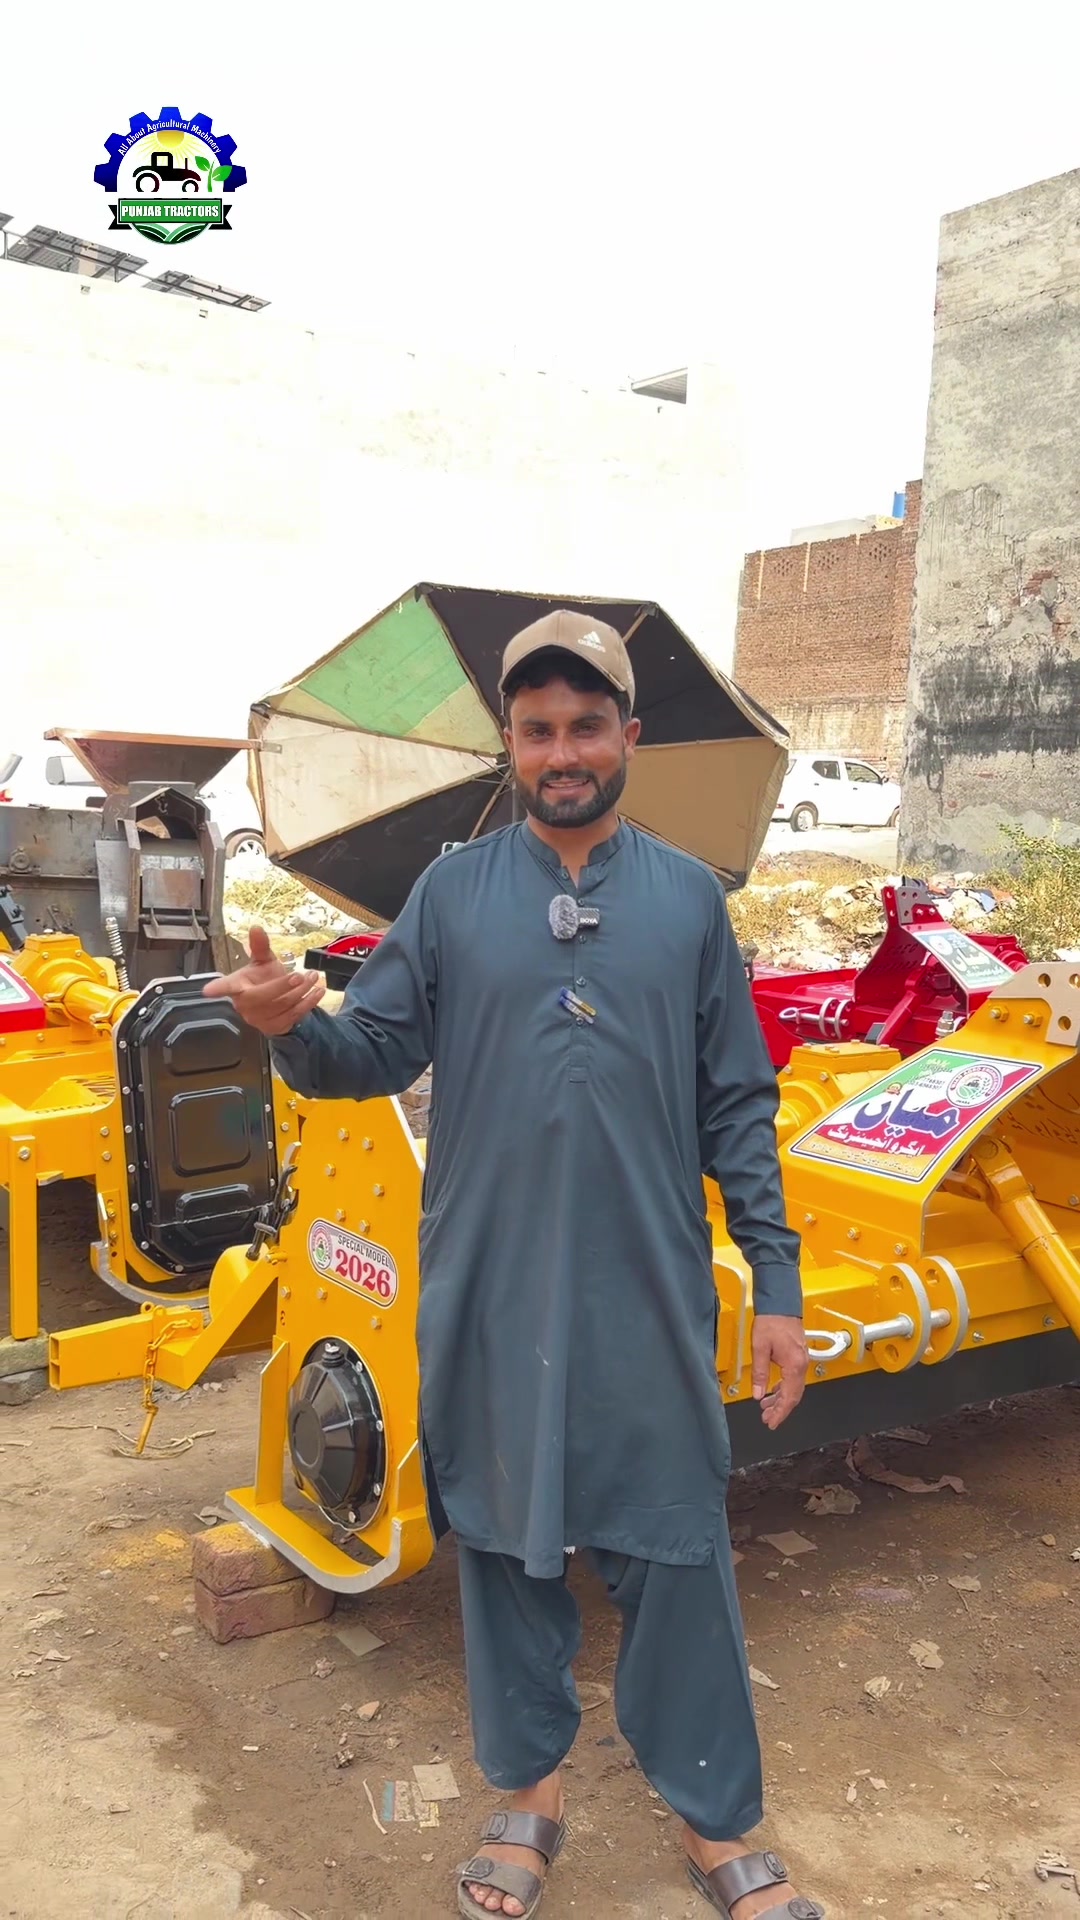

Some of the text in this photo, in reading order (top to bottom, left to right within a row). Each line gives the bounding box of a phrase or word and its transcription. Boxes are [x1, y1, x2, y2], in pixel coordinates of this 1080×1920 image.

[854, 1089, 959, 1137] میاں
[335, 1248, 391, 1298] 2026
[337, 1234, 364, 1256] SPECIAL
[365, 1248, 389, 1267] MODEL
